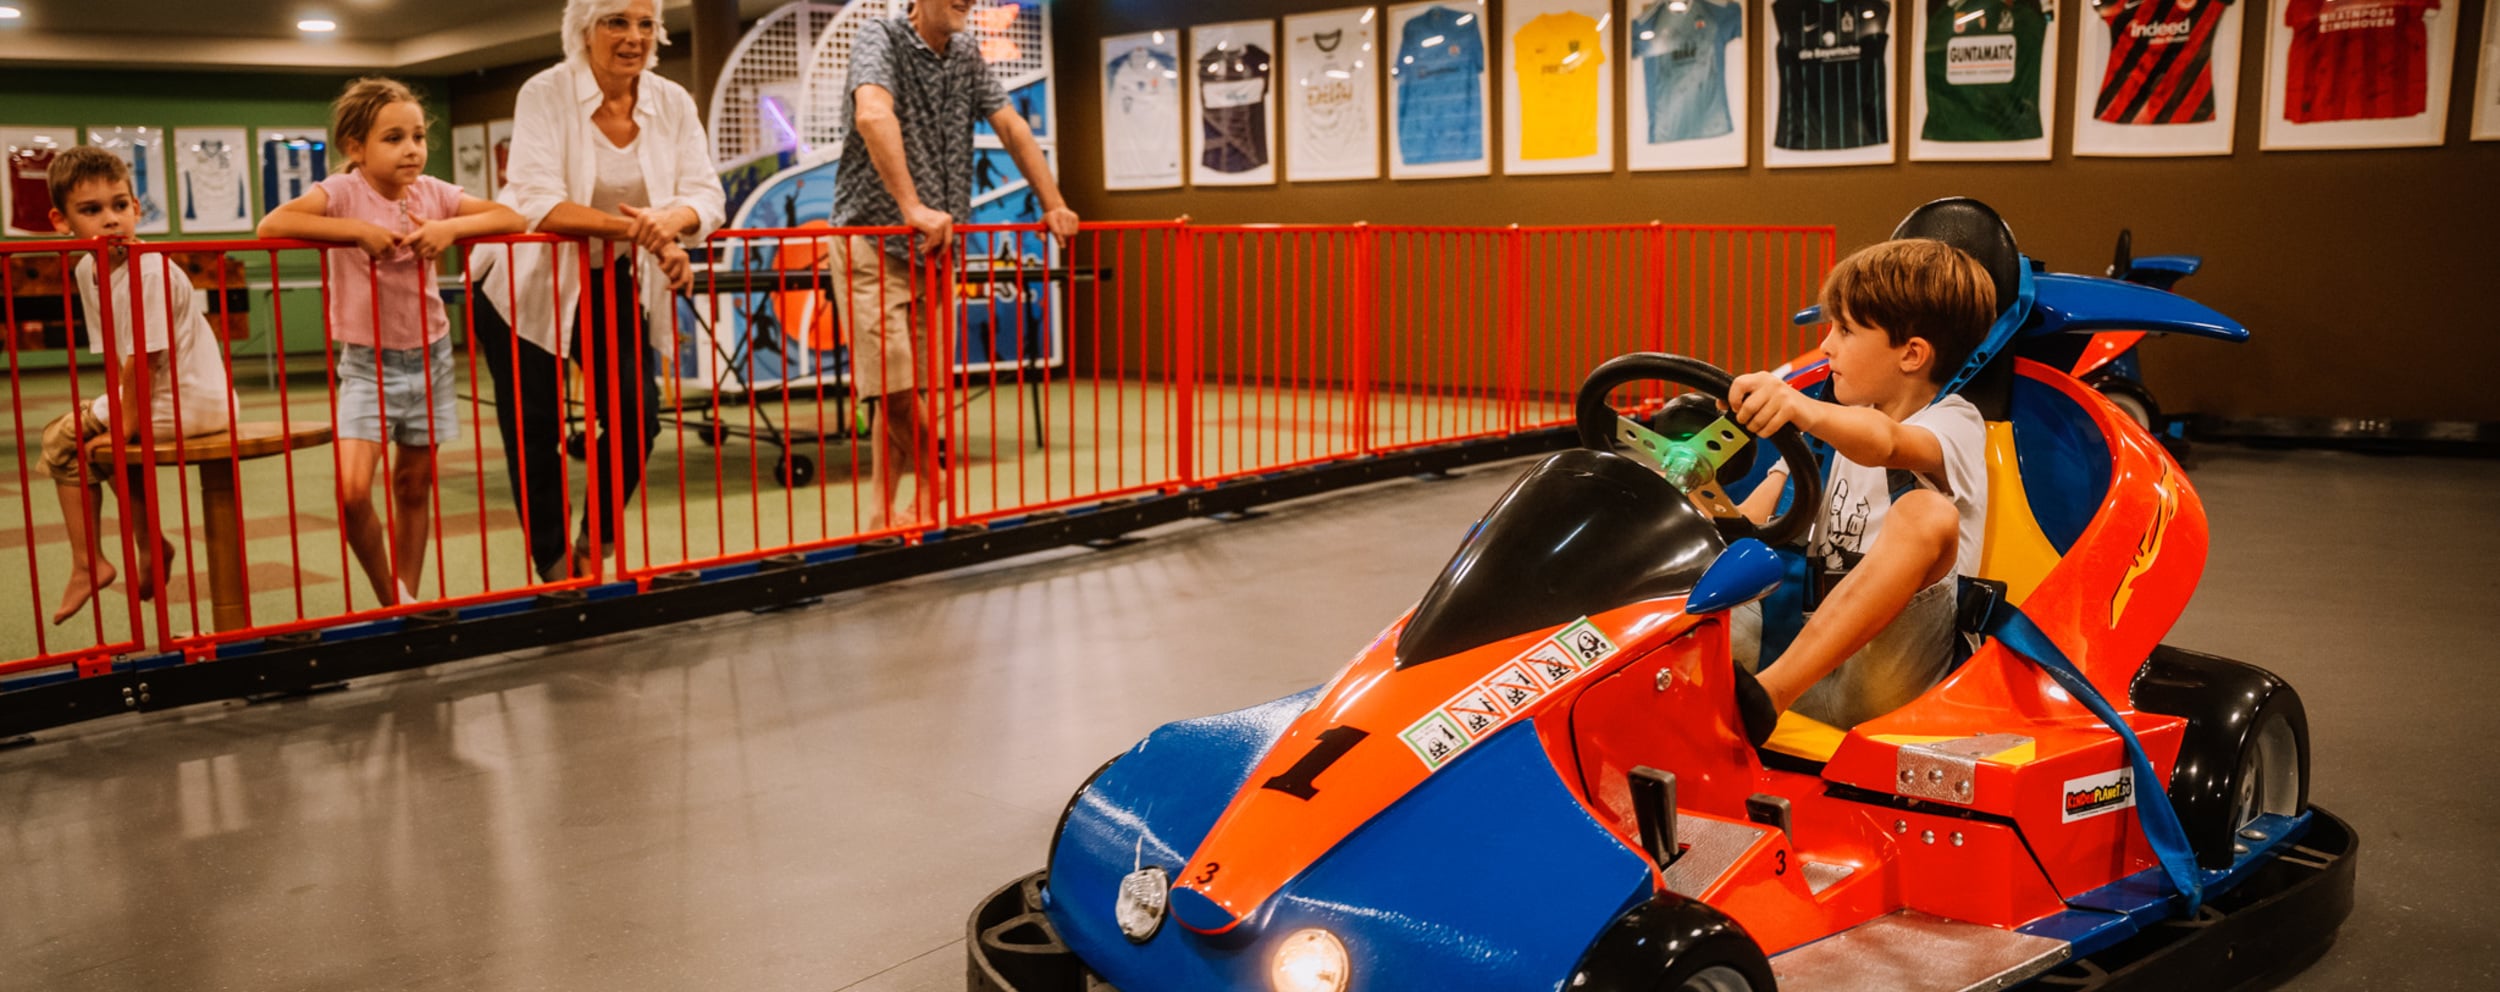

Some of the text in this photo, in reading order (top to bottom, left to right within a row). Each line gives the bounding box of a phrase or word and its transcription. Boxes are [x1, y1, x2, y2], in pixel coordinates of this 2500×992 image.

[2319, 18, 2395, 33] EINDHOVEN
[1950, 44, 2014, 63] GUNTAMATIC
[1261, 724, 1371, 802] 1
[1195, 861, 1220, 885] 3
[1775, 849, 1787, 876] 3
